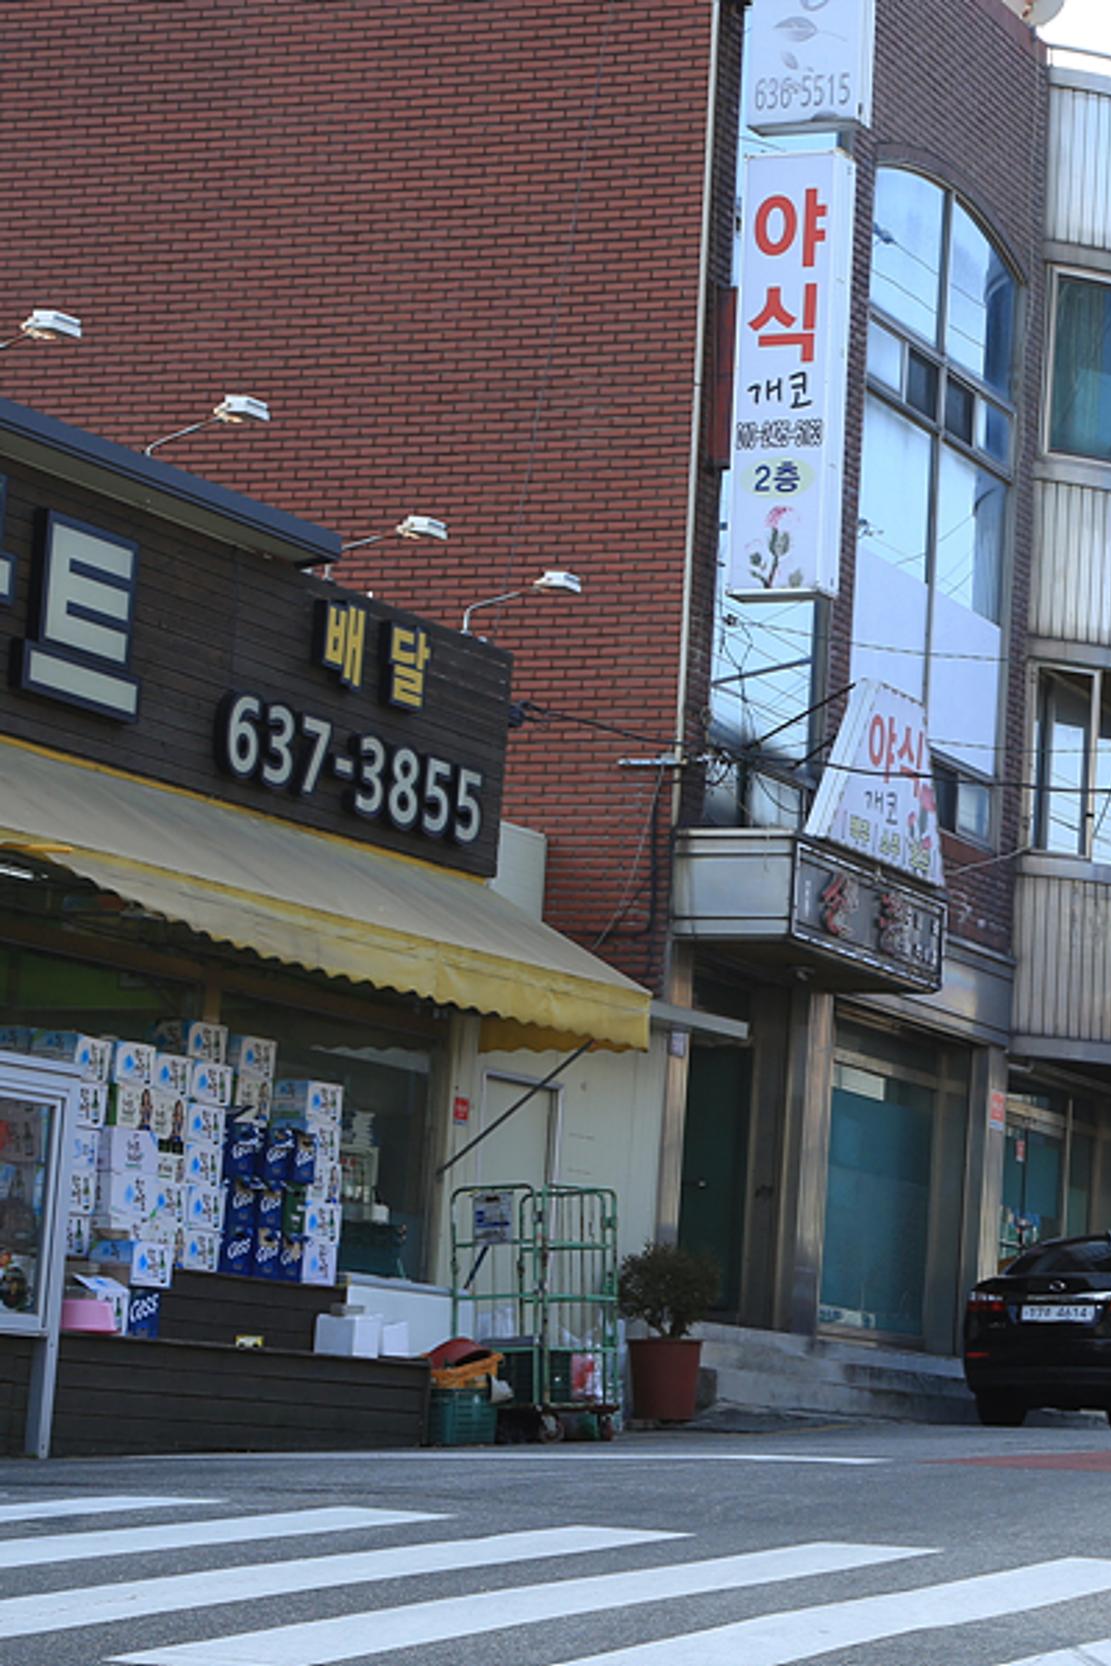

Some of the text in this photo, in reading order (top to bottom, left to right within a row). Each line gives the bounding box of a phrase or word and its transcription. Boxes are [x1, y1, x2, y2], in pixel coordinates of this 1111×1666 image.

[748, 187, 828, 363] 야식
[747, 371, 812, 409] 개코
[754, 461, 801, 493] 2층
[0, 510, 140, 720] 트
[320, 600, 432, 712] 배달
[224, 692, 485, 846] 637-3855
[867, 713, 924, 798] 야식
[864, 790, 898, 826] 개코
